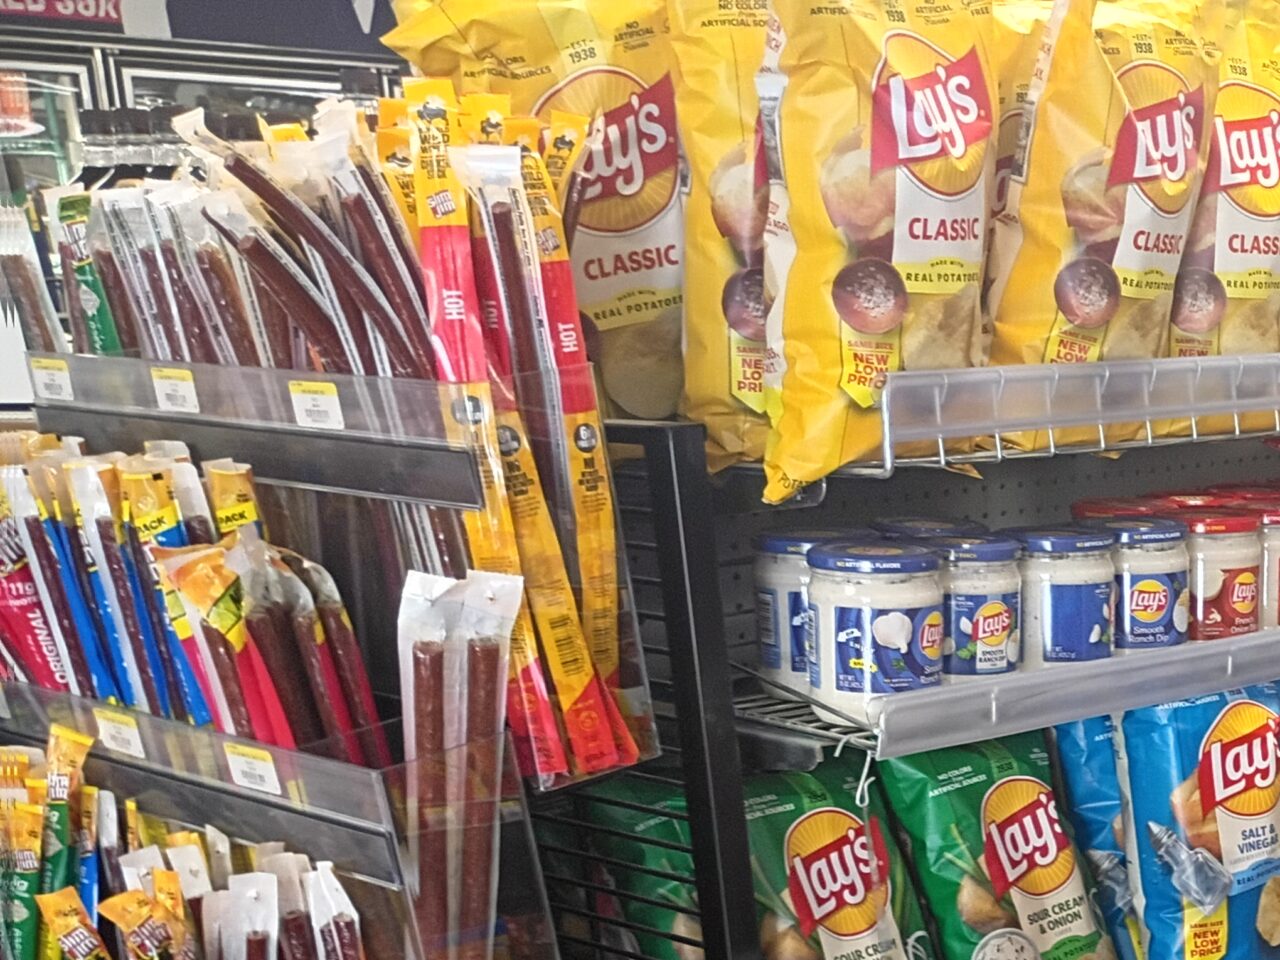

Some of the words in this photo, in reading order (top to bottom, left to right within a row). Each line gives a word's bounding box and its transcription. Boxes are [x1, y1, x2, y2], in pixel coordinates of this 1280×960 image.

[569, 47, 596, 64] 1938
[890, 65, 980, 160] Lay's
[908, 216, 979, 242] CLASSIC
[1133, 229, 1183, 254] CLASSIC
[584, 245, 679, 280] CLASSIC
[906, 272, 933, 282] REAL
[936, 272, 979, 283] POTATOES
[1122, 277, 1144, 288] REAL
[1226, 280, 1247, 289] REAL
[444, 289, 464, 320] HOT
[593, 306, 622, 321] REAL
[627, 295, 684, 315] POTATOES
[561, 322, 578, 353] HOT
[1058, 339, 1092, 354] NEW
[853, 352, 889, 366] NEW
[854, 364, 888, 377] LOW
[1131, 589, 1167, 612] Lay's
[1233, 582, 1257, 604] Lay's
[978, 612, 1010, 637] Lay's
[1133, 626, 1165, 635] Smooth
[27, 608, 69, 684] ORIGINAL
[1129, 634, 1154, 643] Ranch
[1156, 634, 1169, 643] Dip
[990, 793, 1063, 884] Lay's
[1241, 827, 1267, 841] SALT
[1268, 824, 1275, 834] &
[1237, 834, 1279, 854] VINEGAR
[793, 829, 877, 921] Lay's
[1027, 909, 1051, 925] SOUR
[1051, 895, 1084, 916] CREAM
[1039, 923, 1047, 935] &
[1047, 909, 1082, 931] ONION
[1193, 928, 1220, 941] NEW
[1194, 936, 1220, 950] LOW
[1190, 945, 1223, 958] PRICE
